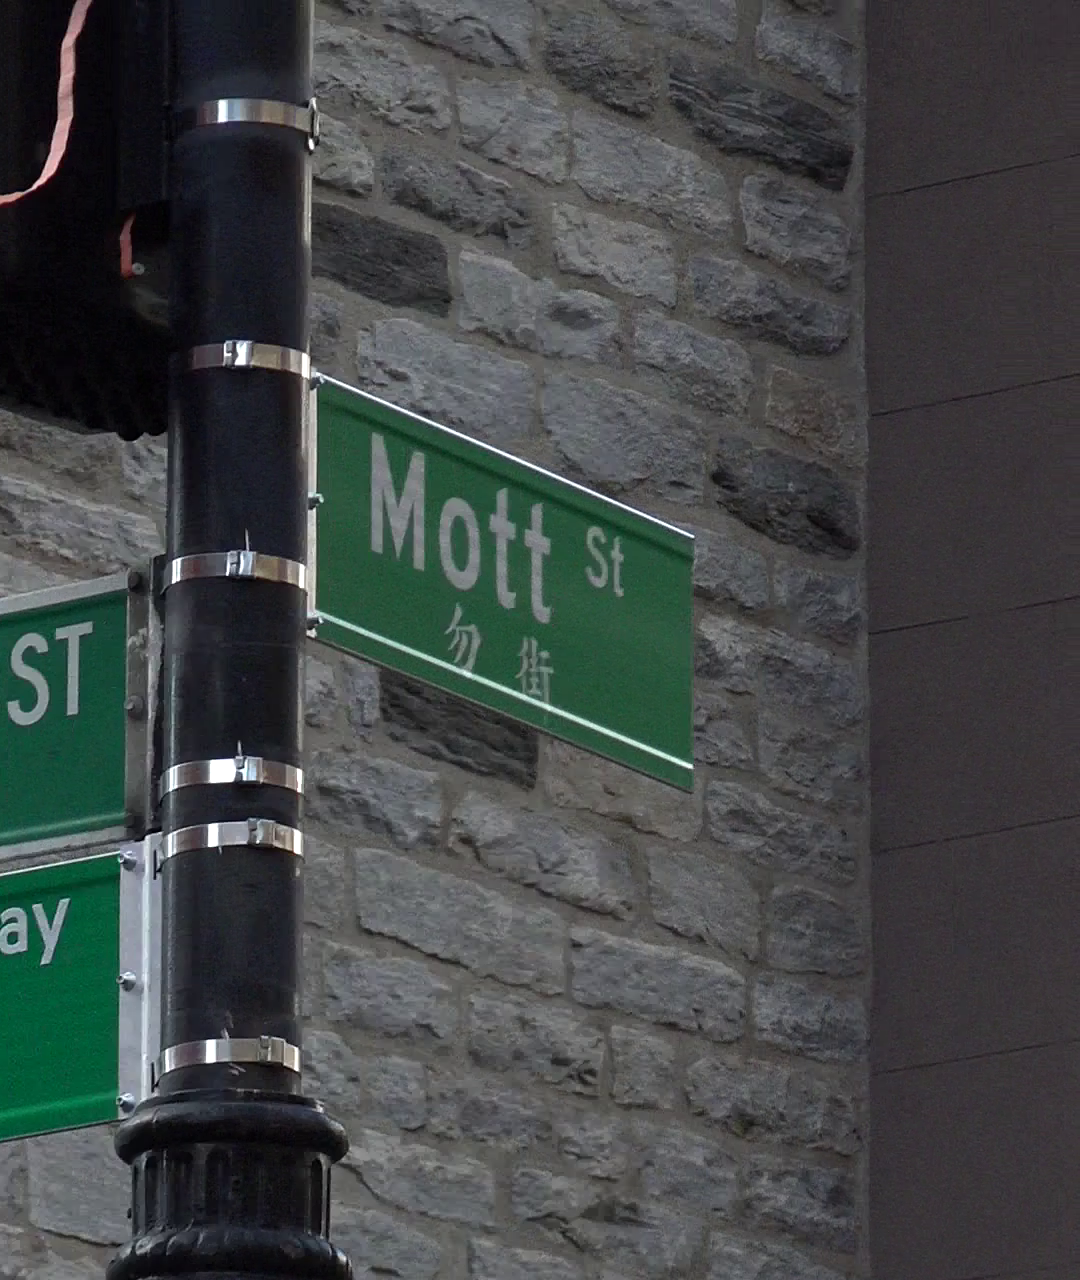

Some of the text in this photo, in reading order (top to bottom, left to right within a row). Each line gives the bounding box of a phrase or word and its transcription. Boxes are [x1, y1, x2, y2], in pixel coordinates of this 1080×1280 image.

[371, 431, 624, 624] Mott St
[7, 621, 93, 726] ST
[444, 603, 554, 727] 勿街
